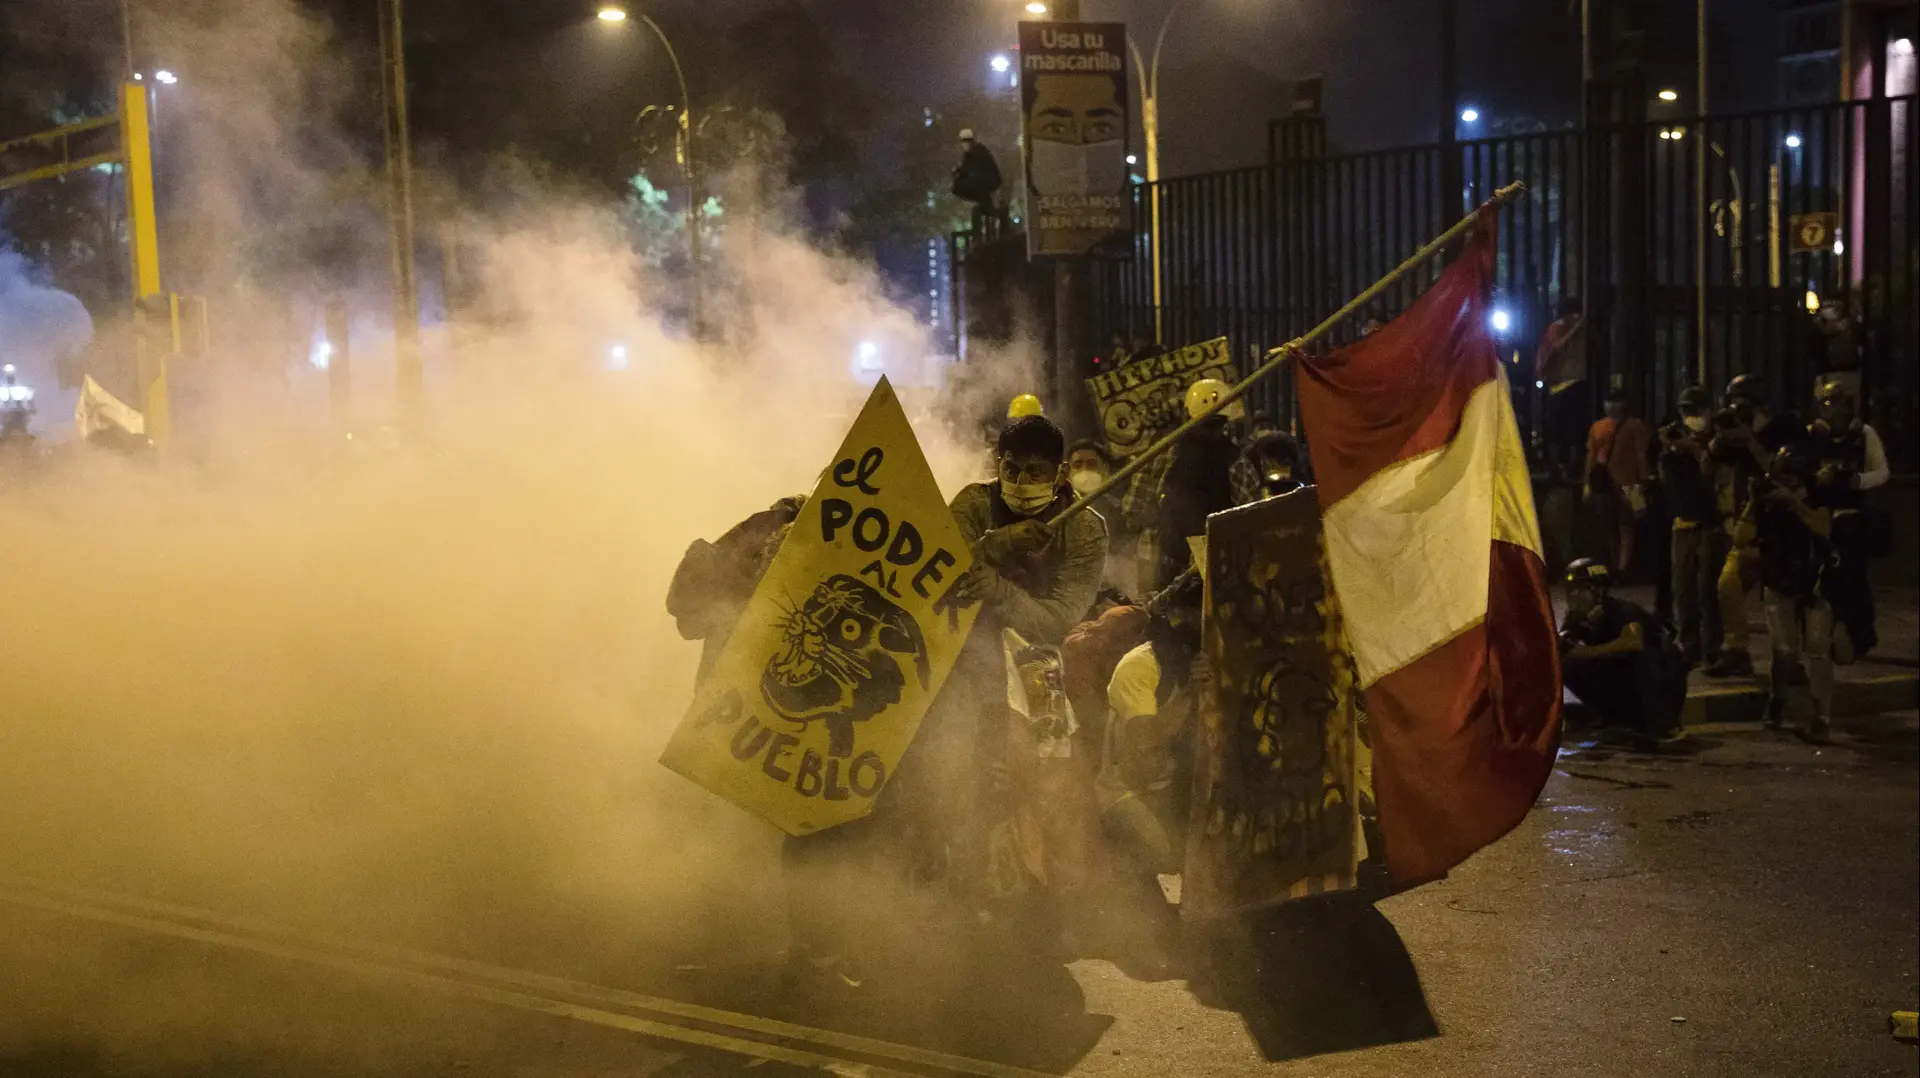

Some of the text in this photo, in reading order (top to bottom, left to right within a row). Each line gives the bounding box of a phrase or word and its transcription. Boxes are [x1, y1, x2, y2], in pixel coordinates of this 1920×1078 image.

[1041, 29, 1104, 50] Usa tu
[1024, 51, 1122, 71] mascarilla
[1807, 225, 1818, 241] 7
[833, 447, 884, 495] el
[860, 560, 902, 598] AL
[694, 687, 885, 801] PUEBLO
